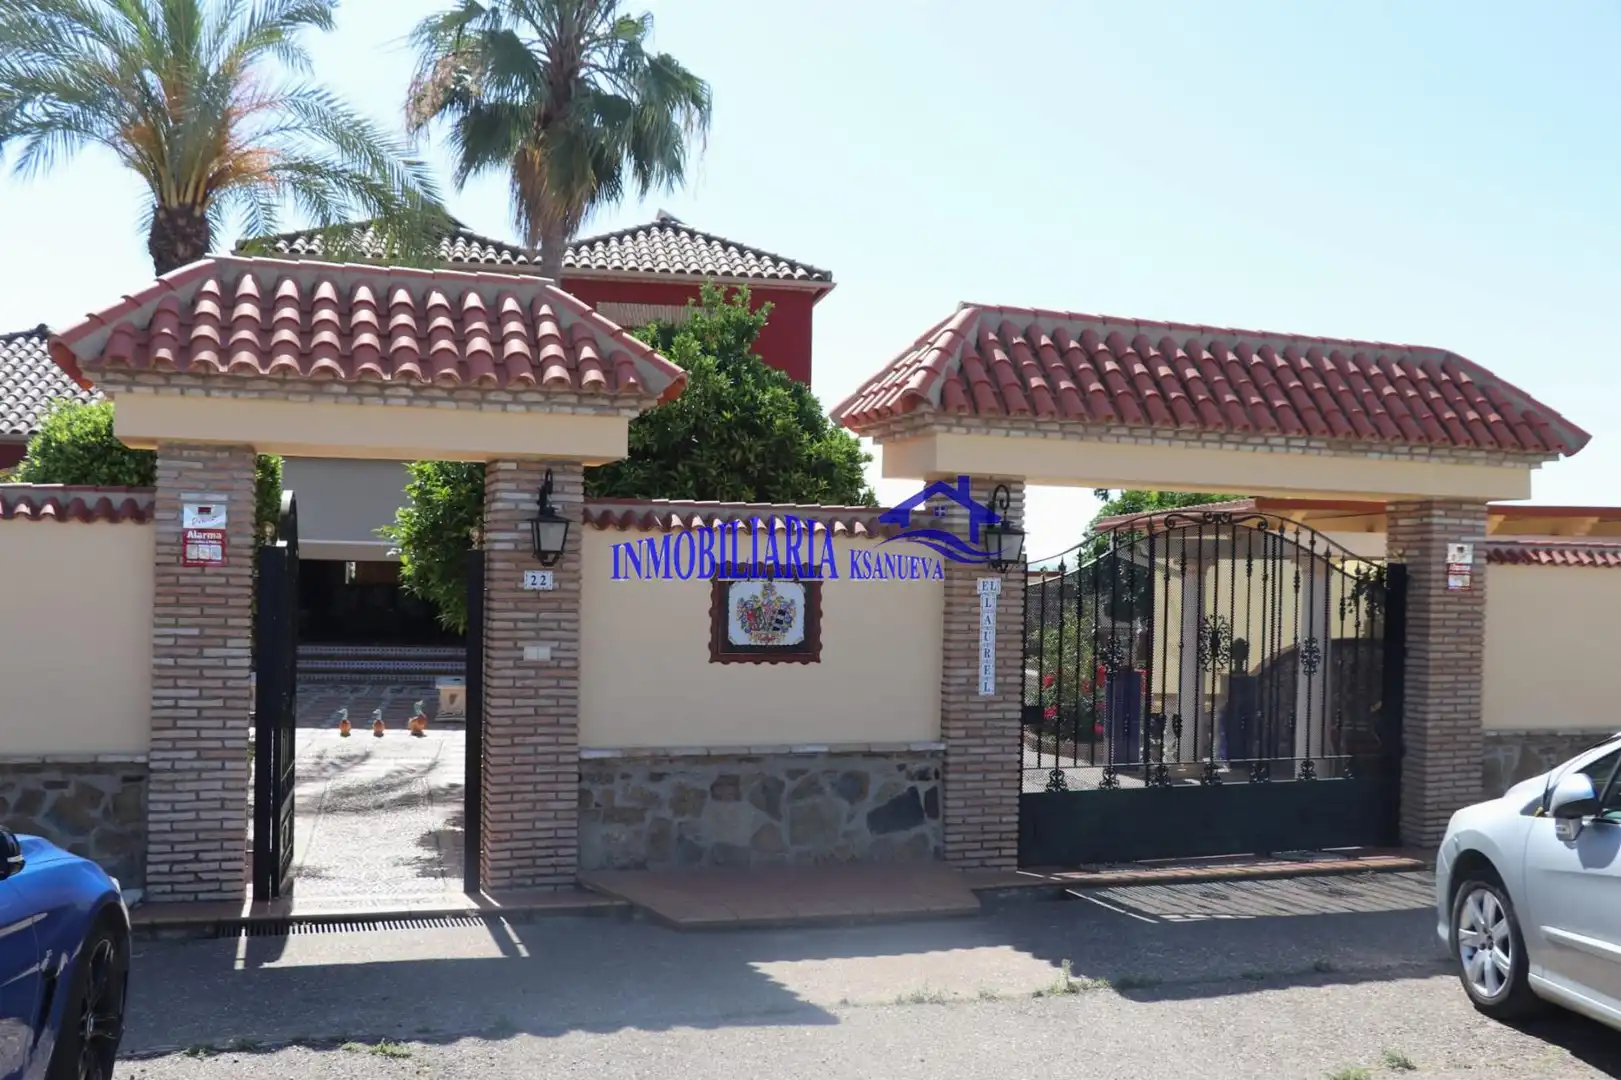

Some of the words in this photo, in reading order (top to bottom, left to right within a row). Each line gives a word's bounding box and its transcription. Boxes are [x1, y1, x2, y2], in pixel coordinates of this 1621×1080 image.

[187, 530, 222, 539] Alarma
[530, 575, 546, 586] 22
[981, 580, 997, 592] EL
[983, 597, 992, 692] LAUREL
